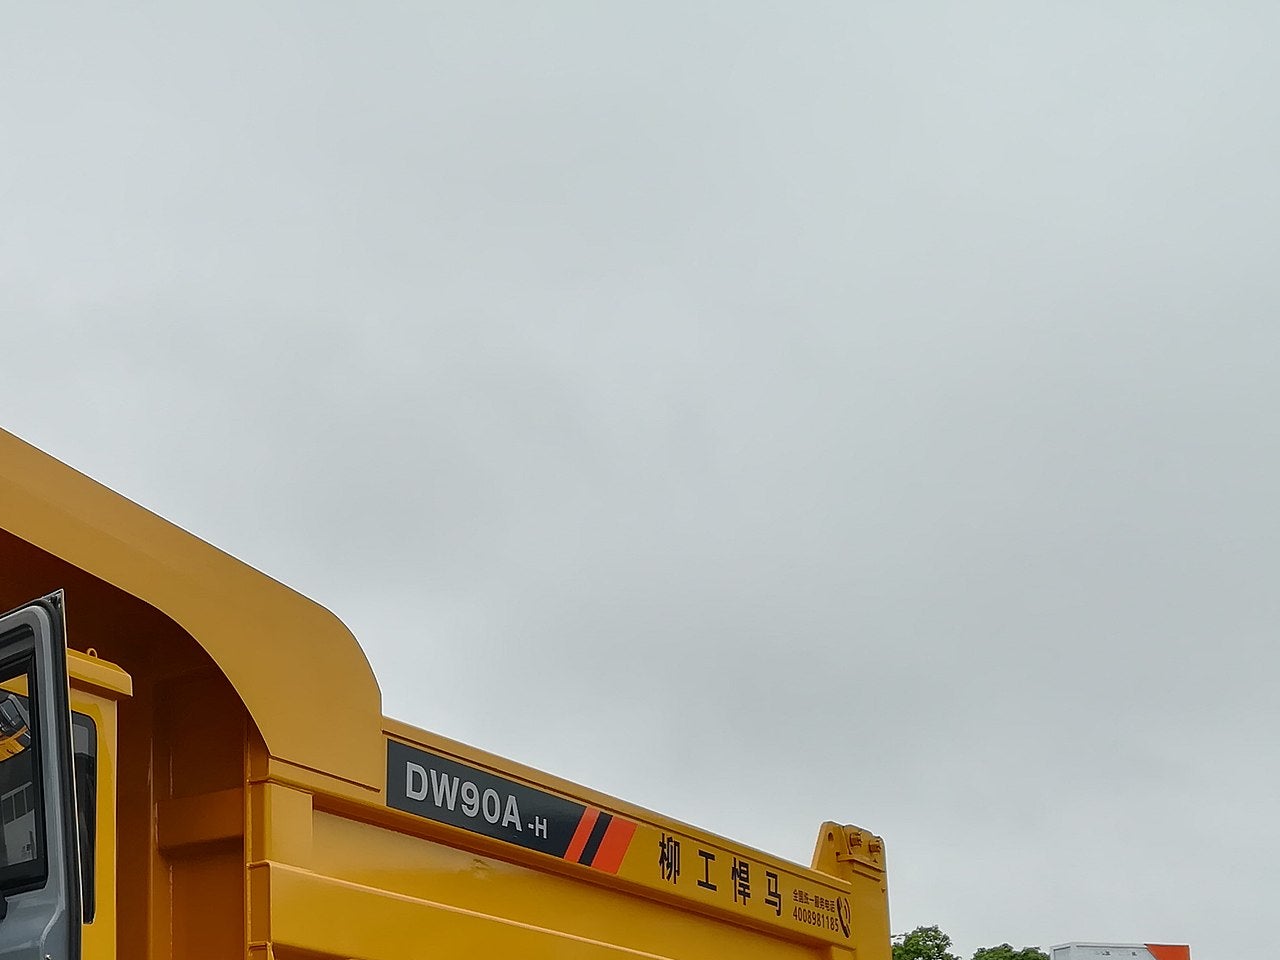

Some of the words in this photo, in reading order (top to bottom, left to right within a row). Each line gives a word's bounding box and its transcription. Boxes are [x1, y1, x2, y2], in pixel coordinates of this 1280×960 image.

[406, 761, 522, 832] DW90A
[659, 832, 782, 917] 柳工悍马
[792, 906, 839, 932] 4008981185
